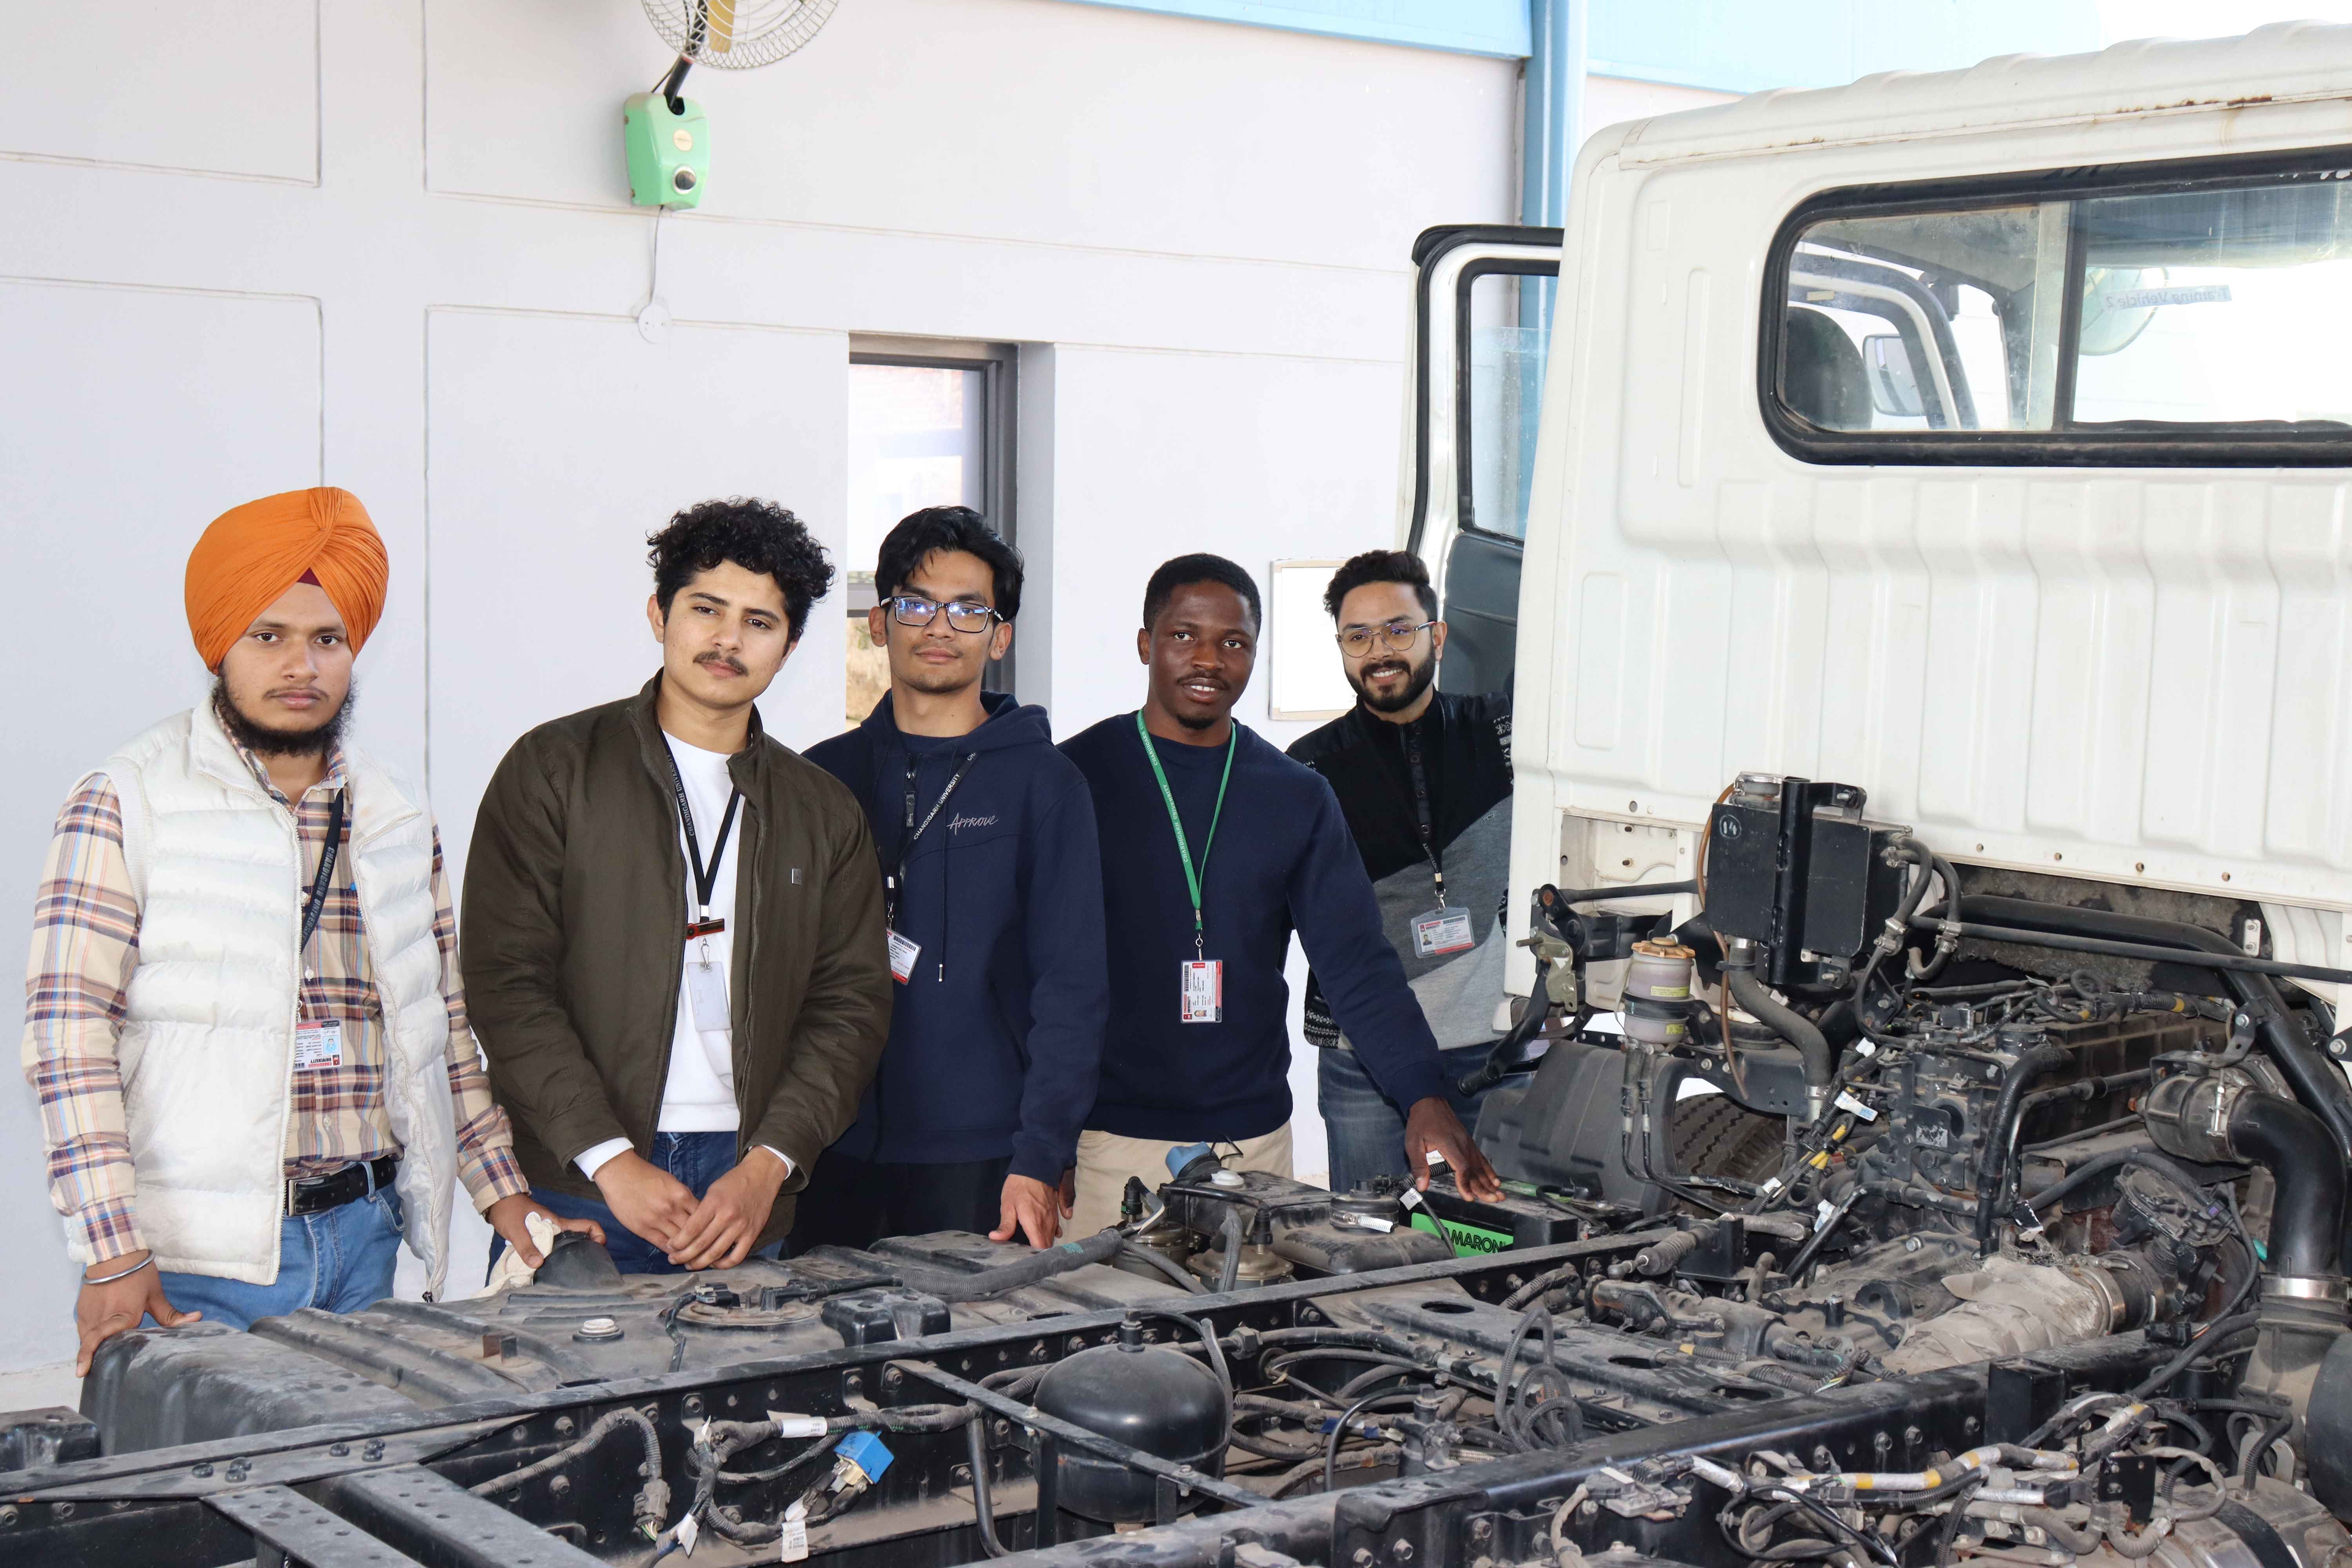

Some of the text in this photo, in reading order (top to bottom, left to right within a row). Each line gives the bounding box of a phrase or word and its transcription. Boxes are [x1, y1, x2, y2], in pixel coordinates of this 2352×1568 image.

[678, 793, 695, 836] CHANDIGARH
[913, 773, 960, 840] CHANDIGARH UNIVERSITY
[1162, 784, 1189, 863] CHANDIGARH UNIVERSITY
[1723, 821, 1738, 835] 14
